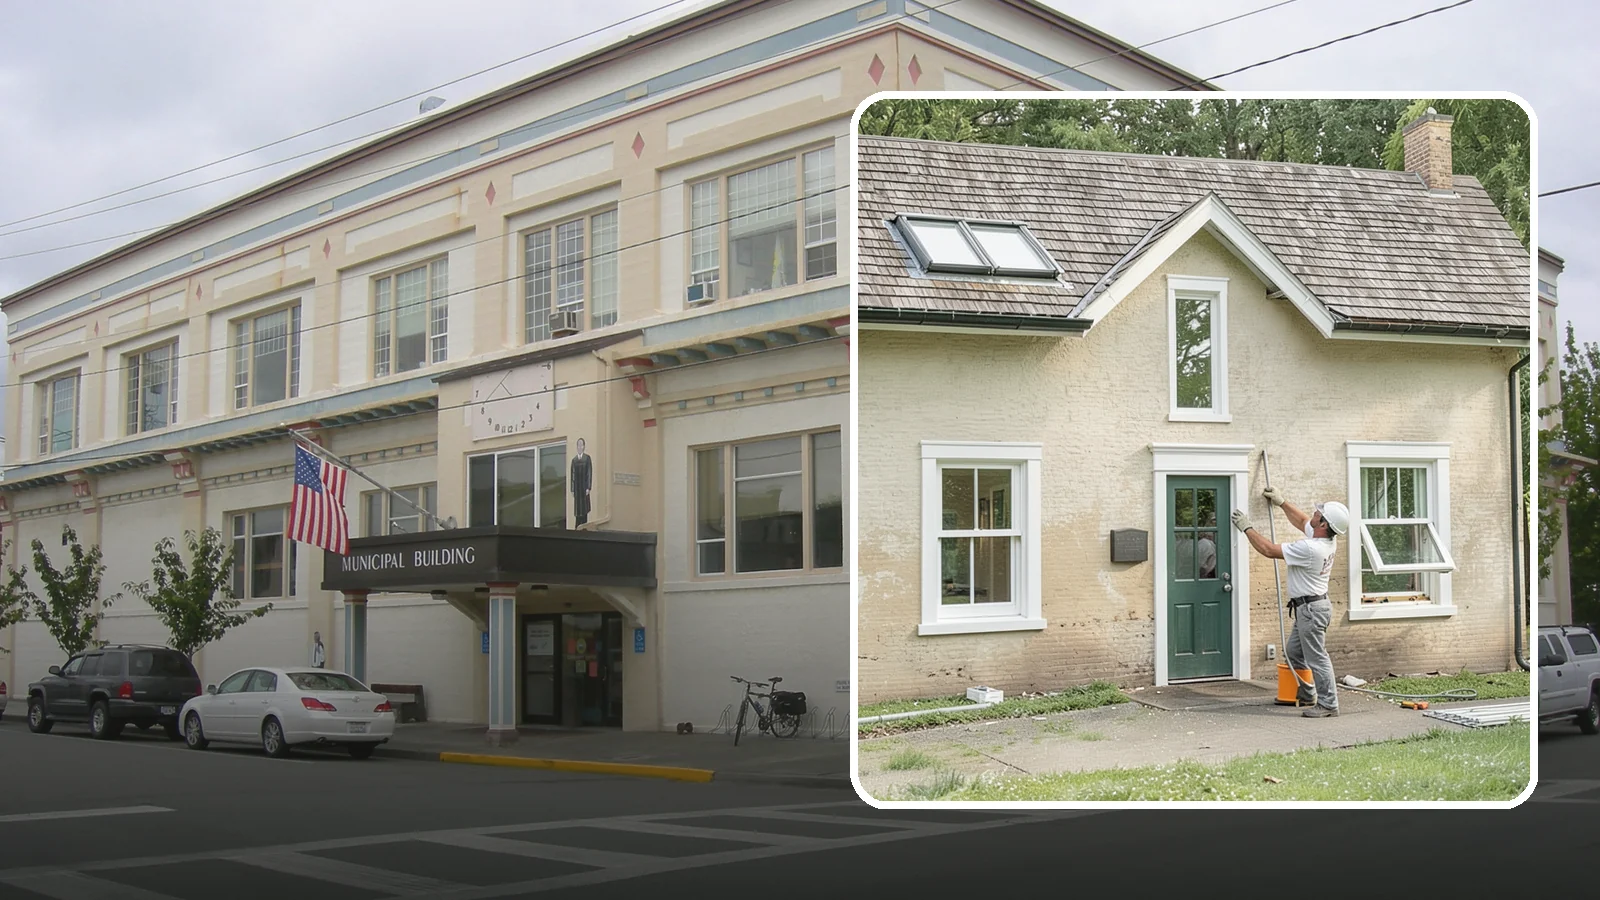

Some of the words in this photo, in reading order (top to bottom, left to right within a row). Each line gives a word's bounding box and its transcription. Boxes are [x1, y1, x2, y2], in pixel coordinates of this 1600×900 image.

[475, 390, 479, 398] 7
[536, 402, 540, 410] 4
[480, 407, 485, 415] 8
[487, 417, 492, 425] 9
[528, 414, 533, 422] 3
[494, 423, 500, 432] 10
[521, 420, 526, 428] 2
[507, 425, 513, 433] 12
[342, 552, 405, 572] MUNICIPAL
[414, 546, 475, 567] BUILDING
